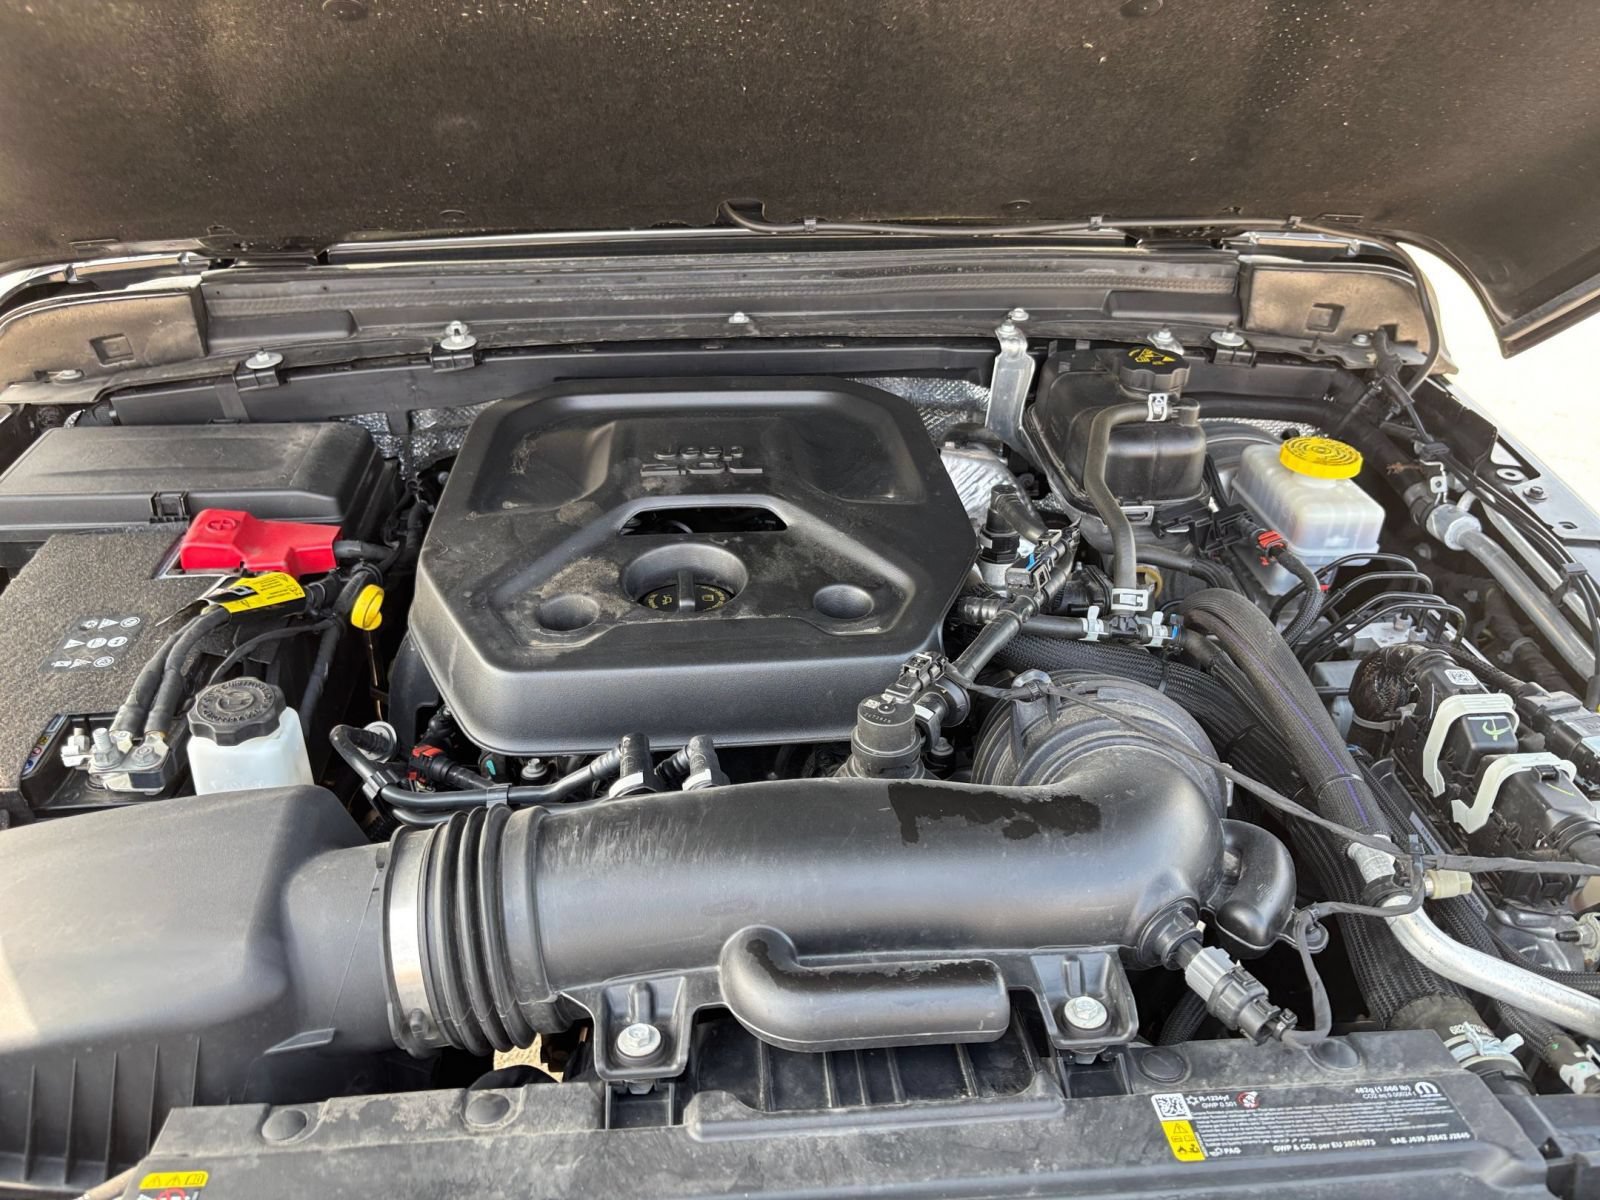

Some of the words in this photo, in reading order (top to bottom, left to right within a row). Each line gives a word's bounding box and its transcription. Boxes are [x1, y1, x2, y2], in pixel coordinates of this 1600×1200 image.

[653, 445, 745, 461] Jeep
[1199, 1094, 1230, 1103] R-1234yf
[1390, 1137, 1407, 1145] SAE
[1223, 1147, 1241, 1155] PAG
[1273, 1144, 1291, 1152] GWP
[1331, 1141, 1343, 1149] EU
